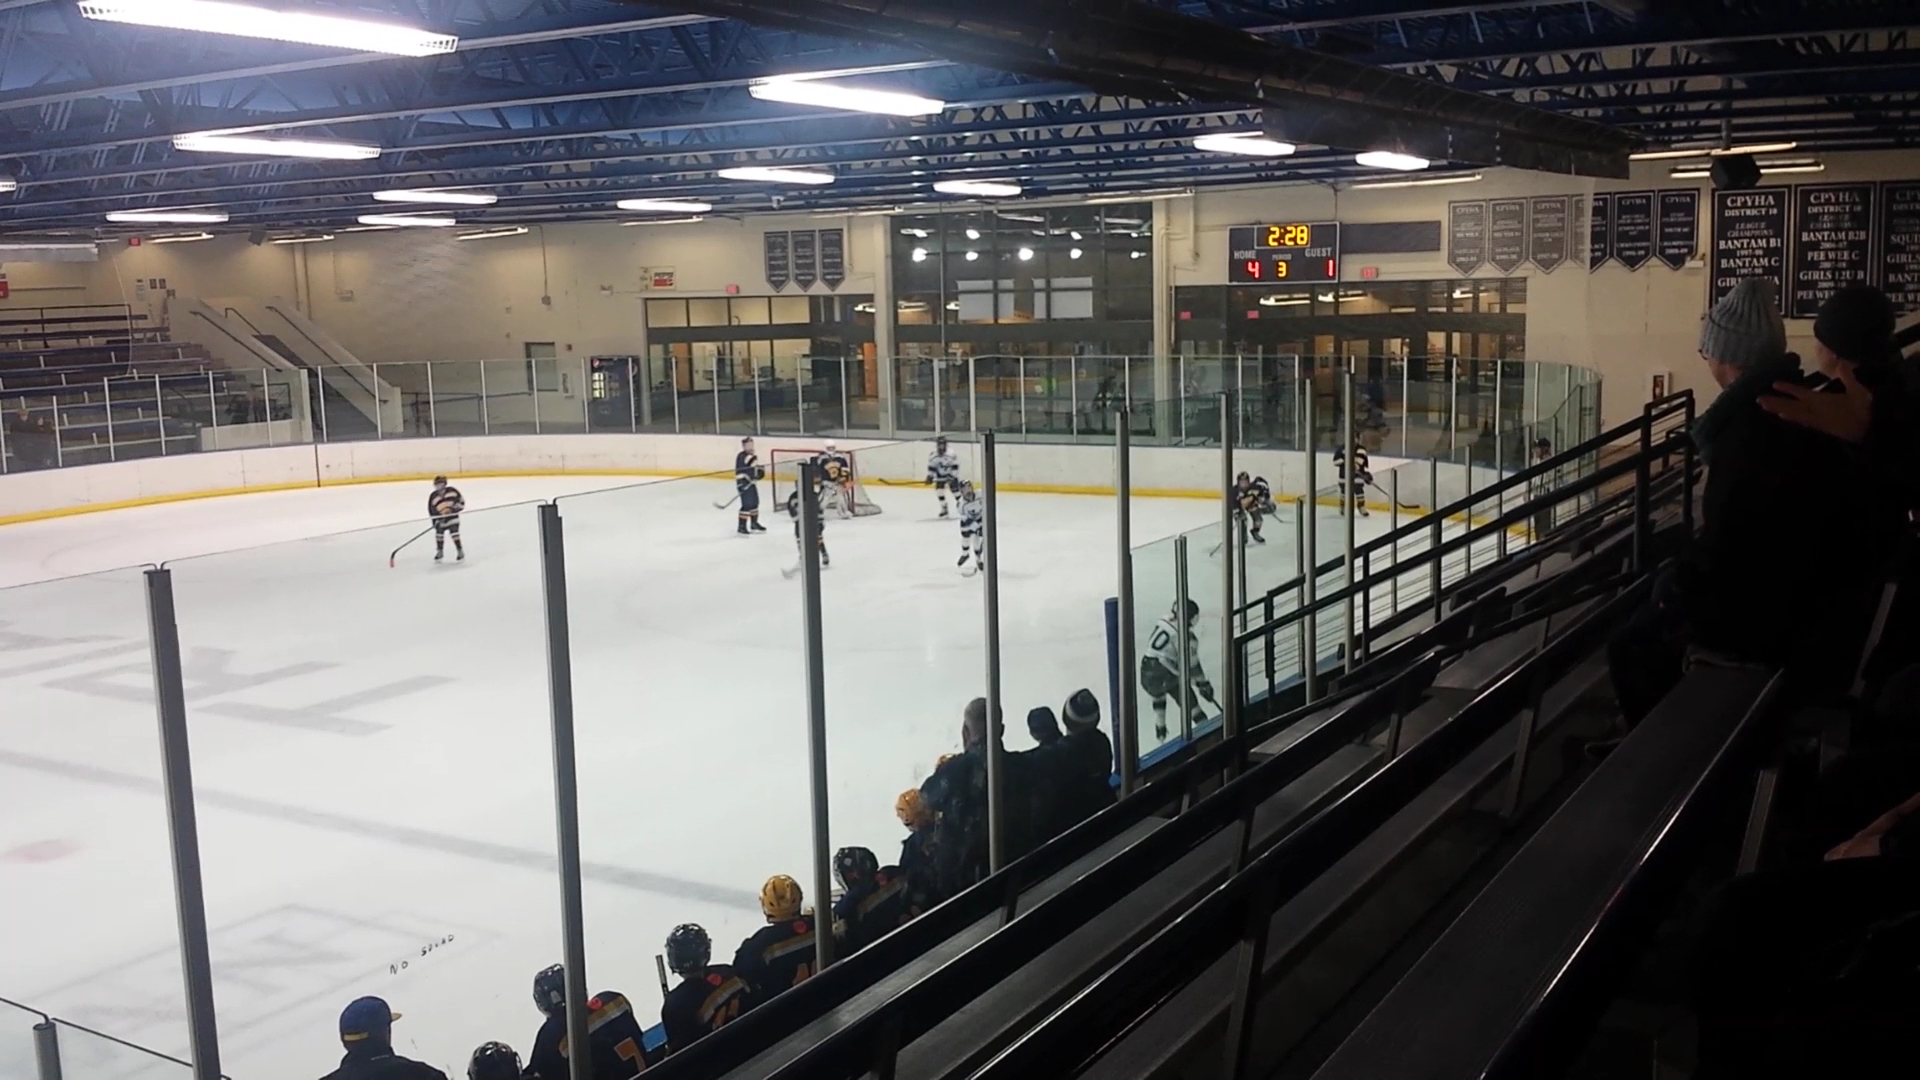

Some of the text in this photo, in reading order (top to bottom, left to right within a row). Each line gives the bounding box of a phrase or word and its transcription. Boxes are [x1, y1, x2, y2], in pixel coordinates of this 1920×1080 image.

[1727, 195, 1775, 207] CPYHA
[1810, 191, 1860, 204] CPYHA
[1725, 207, 1778, 217] DISTRICT 10
[1808, 204, 1862, 214] DISTRICT 10
[1735, 222, 1766, 230] LEAGUE
[1268, 225, 1308, 246] 2:28
[1727, 229, 1774, 238] CHAMPIONS
[1802, 230, 1867, 242] BANTAM B2B
[1719, 237, 1781, 250] BANTAM B1
[1234, 247, 1332, 261] HOME PERIOD GUEST
[1807, 250, 1860, 261] PEE WEE C
[1247, 259, 1334, 278] 4 3 1
[1721, 257, 1779, 269] BANTAM C
[1799, 270, 1832, 281] GIRLS
[1857, 270, 1865, 280] B
[390, 961, 408, 975] NO
